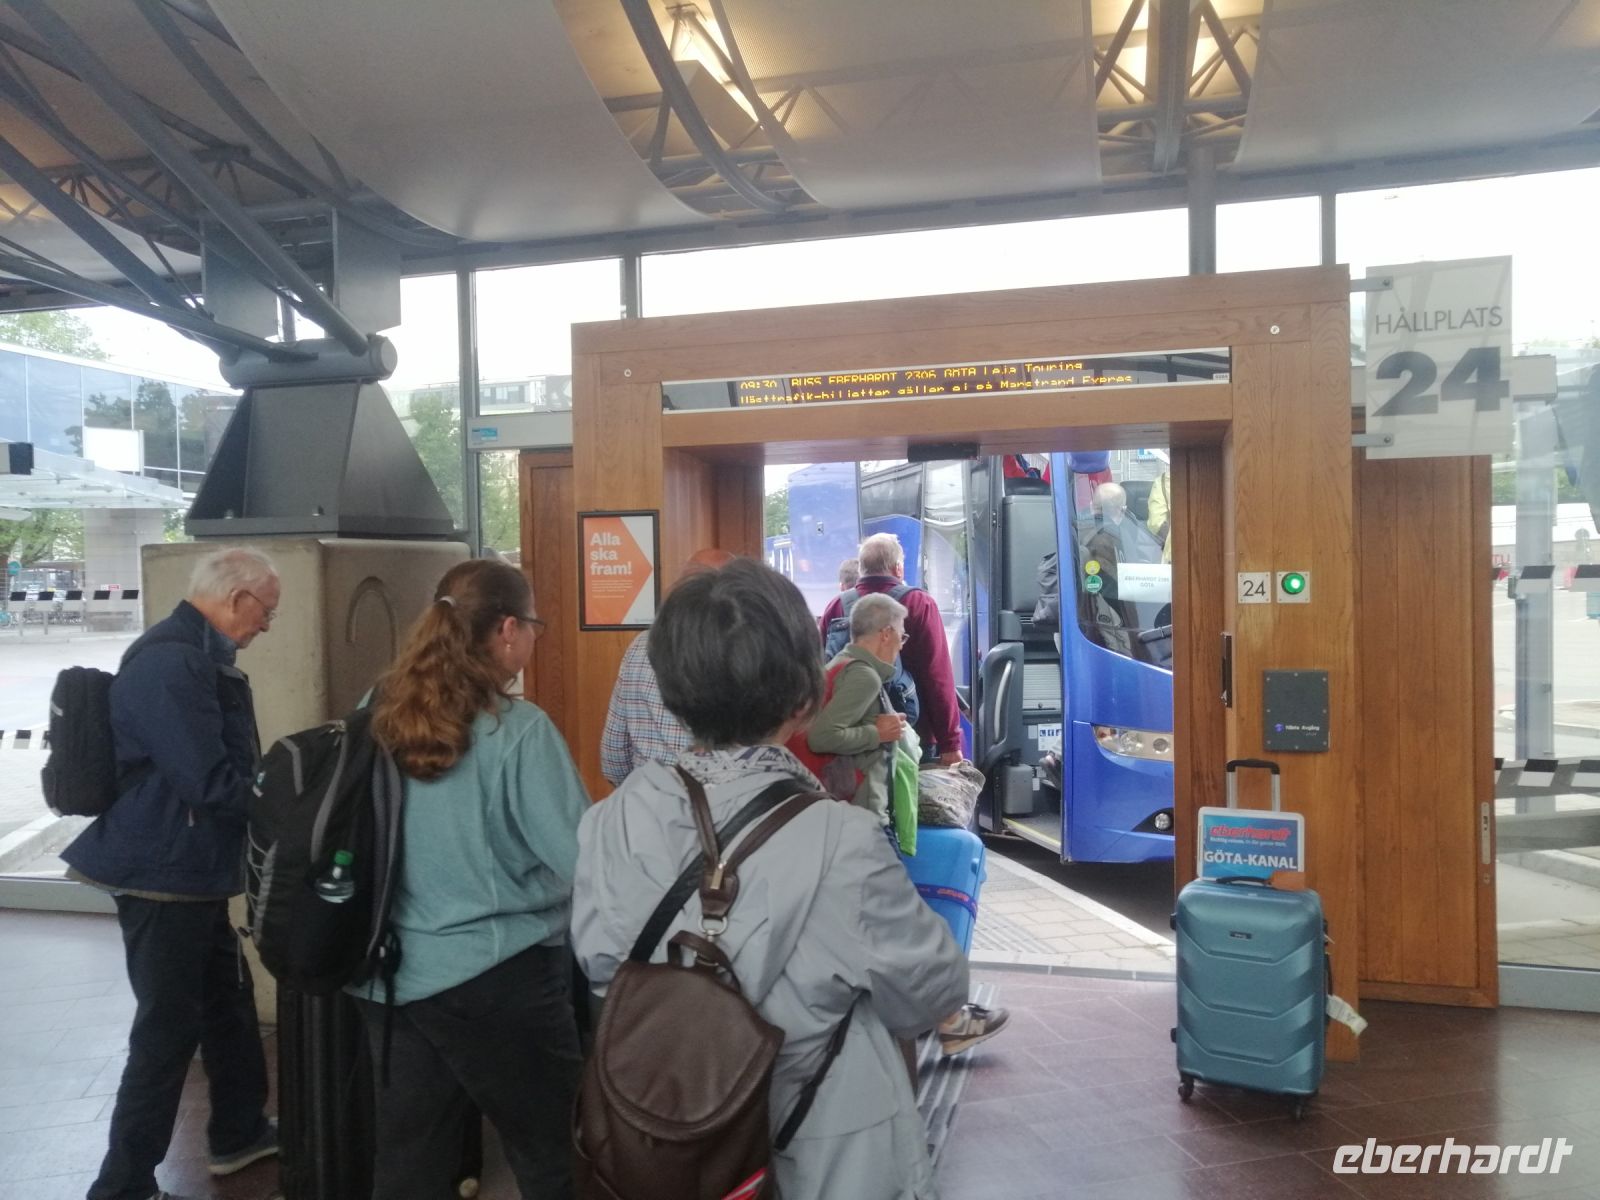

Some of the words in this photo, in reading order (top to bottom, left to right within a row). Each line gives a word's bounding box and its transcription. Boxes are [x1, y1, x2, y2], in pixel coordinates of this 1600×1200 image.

[1375, 306, 1503, 335] HÅLLPLATS
[1372, 346, 1510, 416] 24
[590, 532, 621, 546] Alla
[590, 548, 618, 561] ska
[590, 562, 632, 576] fram!
[1243, 580, 1266, 597] 24
[1204, 849, 1297, 869] GÖTA-KANAL
